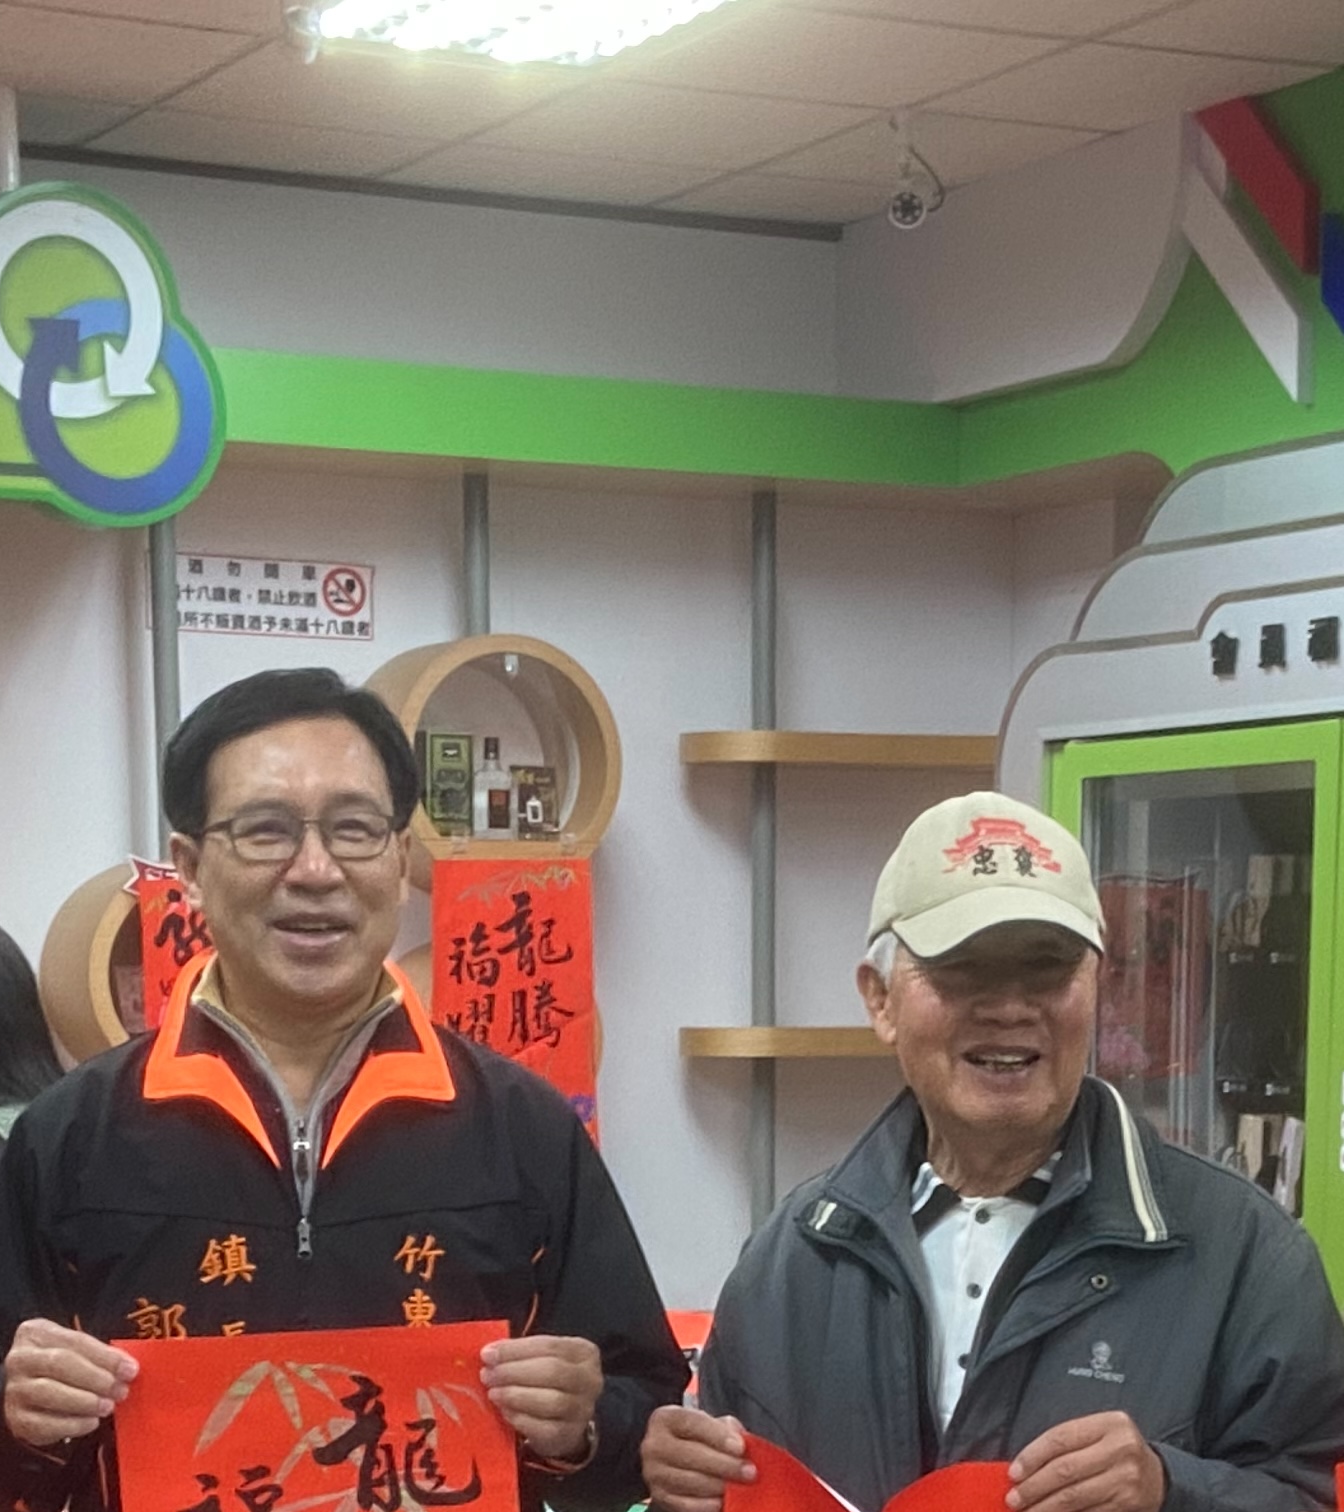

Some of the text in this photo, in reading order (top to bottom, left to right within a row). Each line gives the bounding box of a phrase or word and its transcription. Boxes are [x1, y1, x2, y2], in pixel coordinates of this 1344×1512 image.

[177, 611, 371, 637] 所不販賣酒予未滿十八歲者
